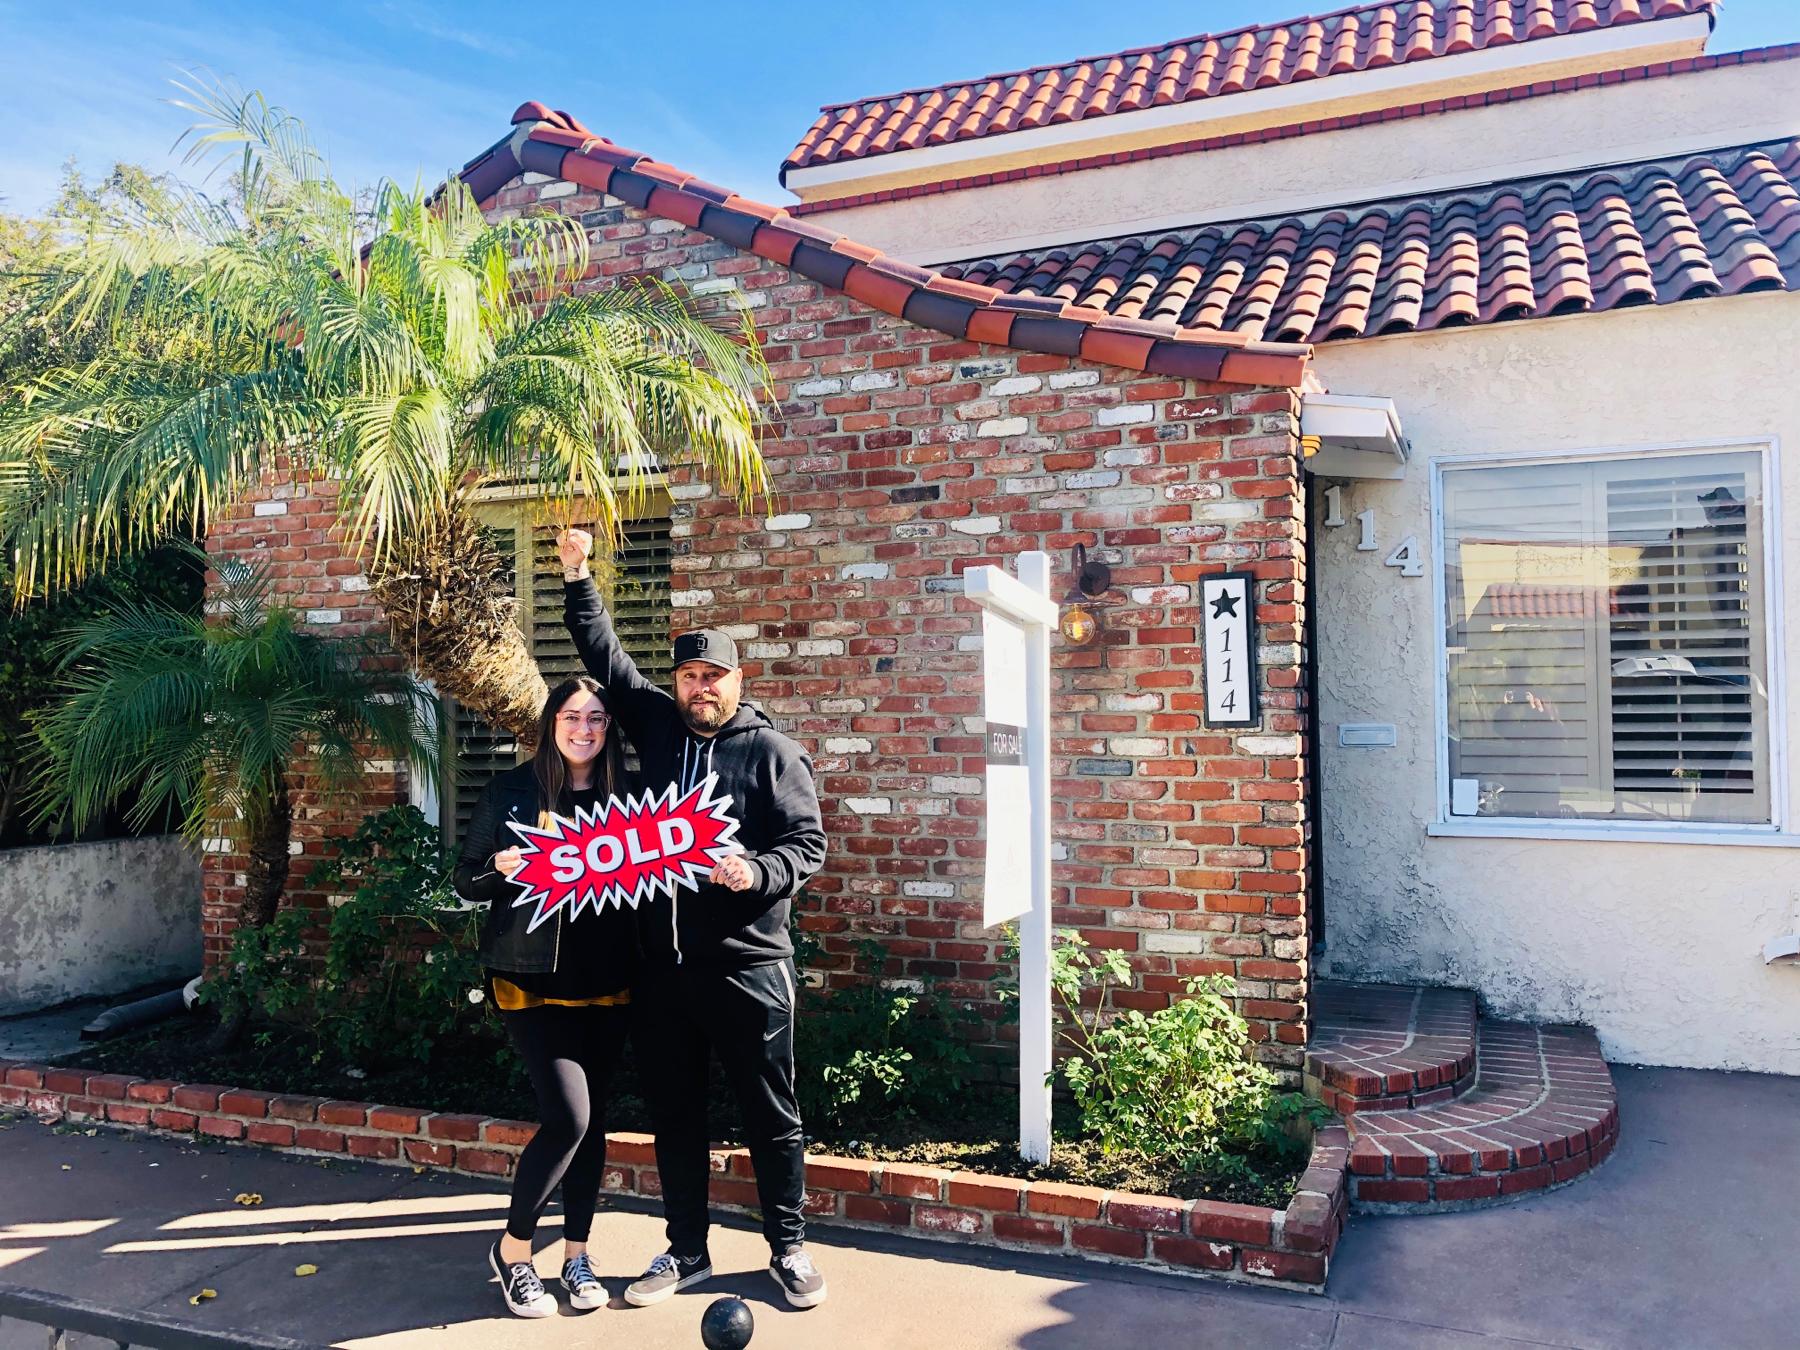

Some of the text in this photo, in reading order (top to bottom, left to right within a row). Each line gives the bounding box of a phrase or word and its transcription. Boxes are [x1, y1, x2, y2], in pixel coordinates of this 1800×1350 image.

[1324, 485, 1424, 577] 114
[1220, 627, 1236, 714] 114
[993, 732, 1024, 755] FOR SALE
[549, 817, 695, 883] SOLD
